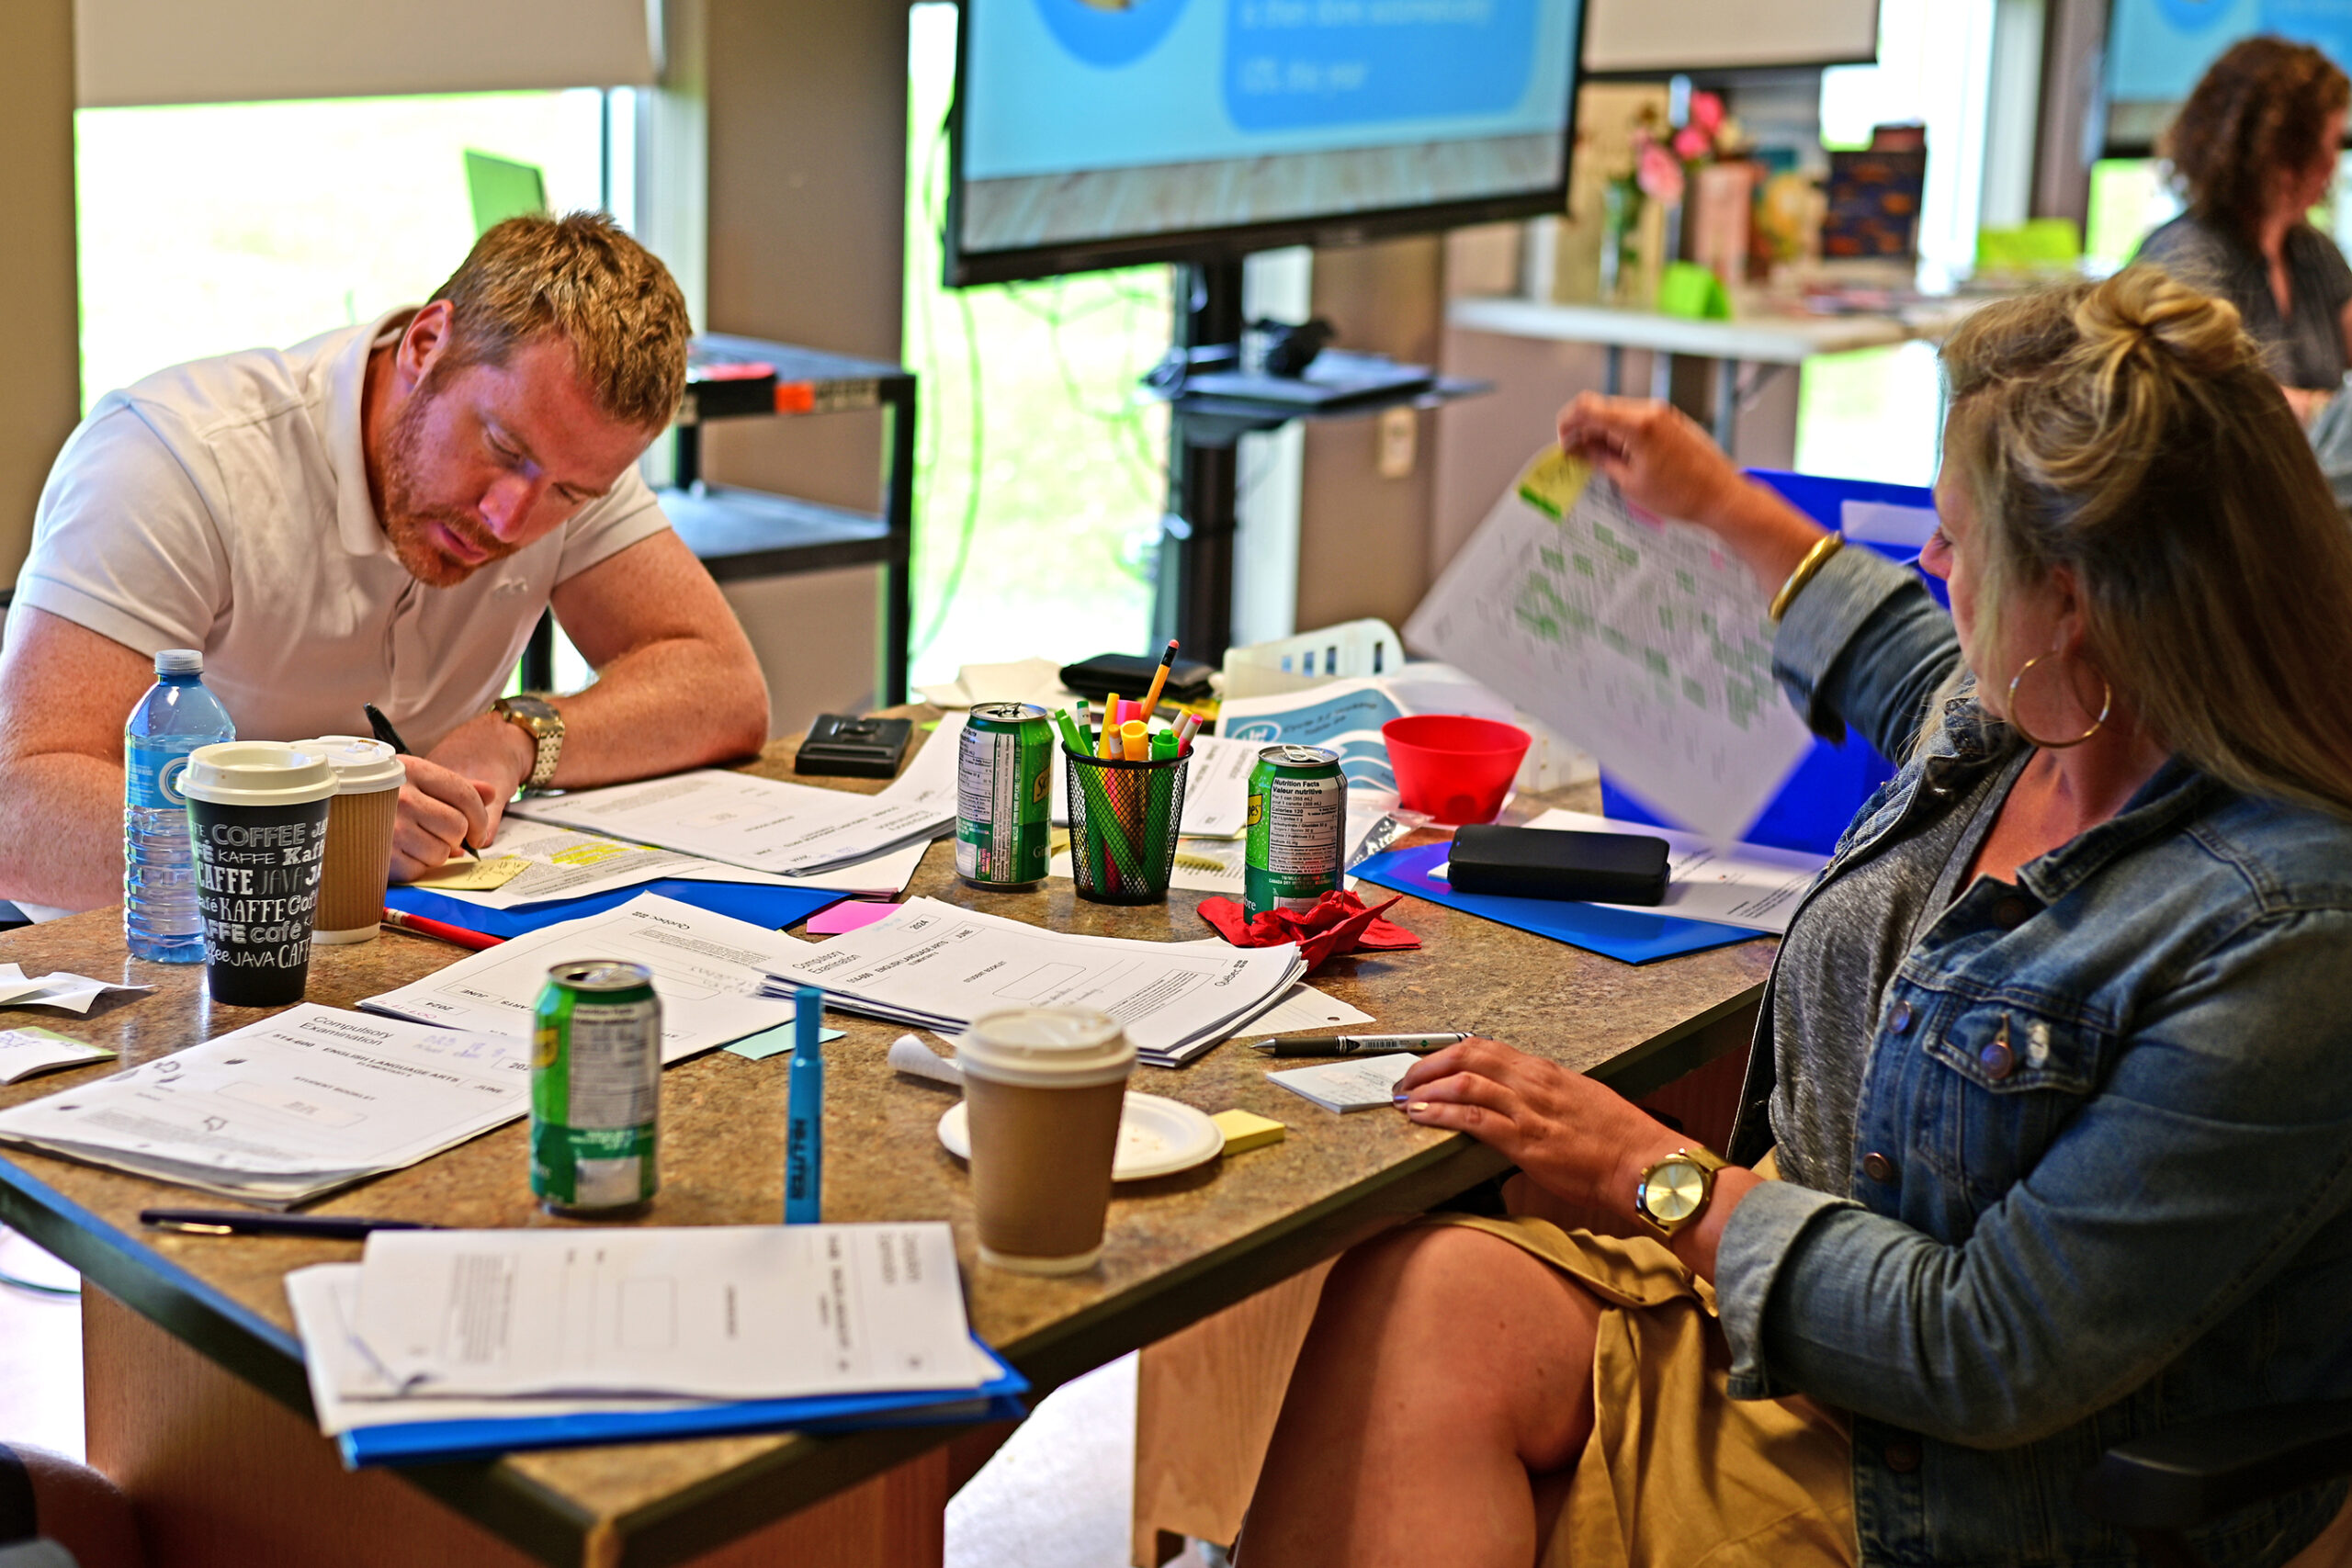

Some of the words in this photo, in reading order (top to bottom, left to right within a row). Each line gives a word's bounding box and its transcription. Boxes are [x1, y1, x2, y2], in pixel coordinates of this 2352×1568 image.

[1273, 779, 1302, 787] Nutrition
[212, 822, 307, 848] COFFEE
[218, 849, 277, 864] KAFFE
[197, 861, 254, 896] CAFFE
[255, 867, 304, 896] JAVA
[220, 897, 287, 923] KAFFE
[250, 919, 302, 943] café
[231, 951, 275, 968] JAVA
[299, 1021, 383, 1046] Examination
[312, 1016, 394, 1040] Compulsory
